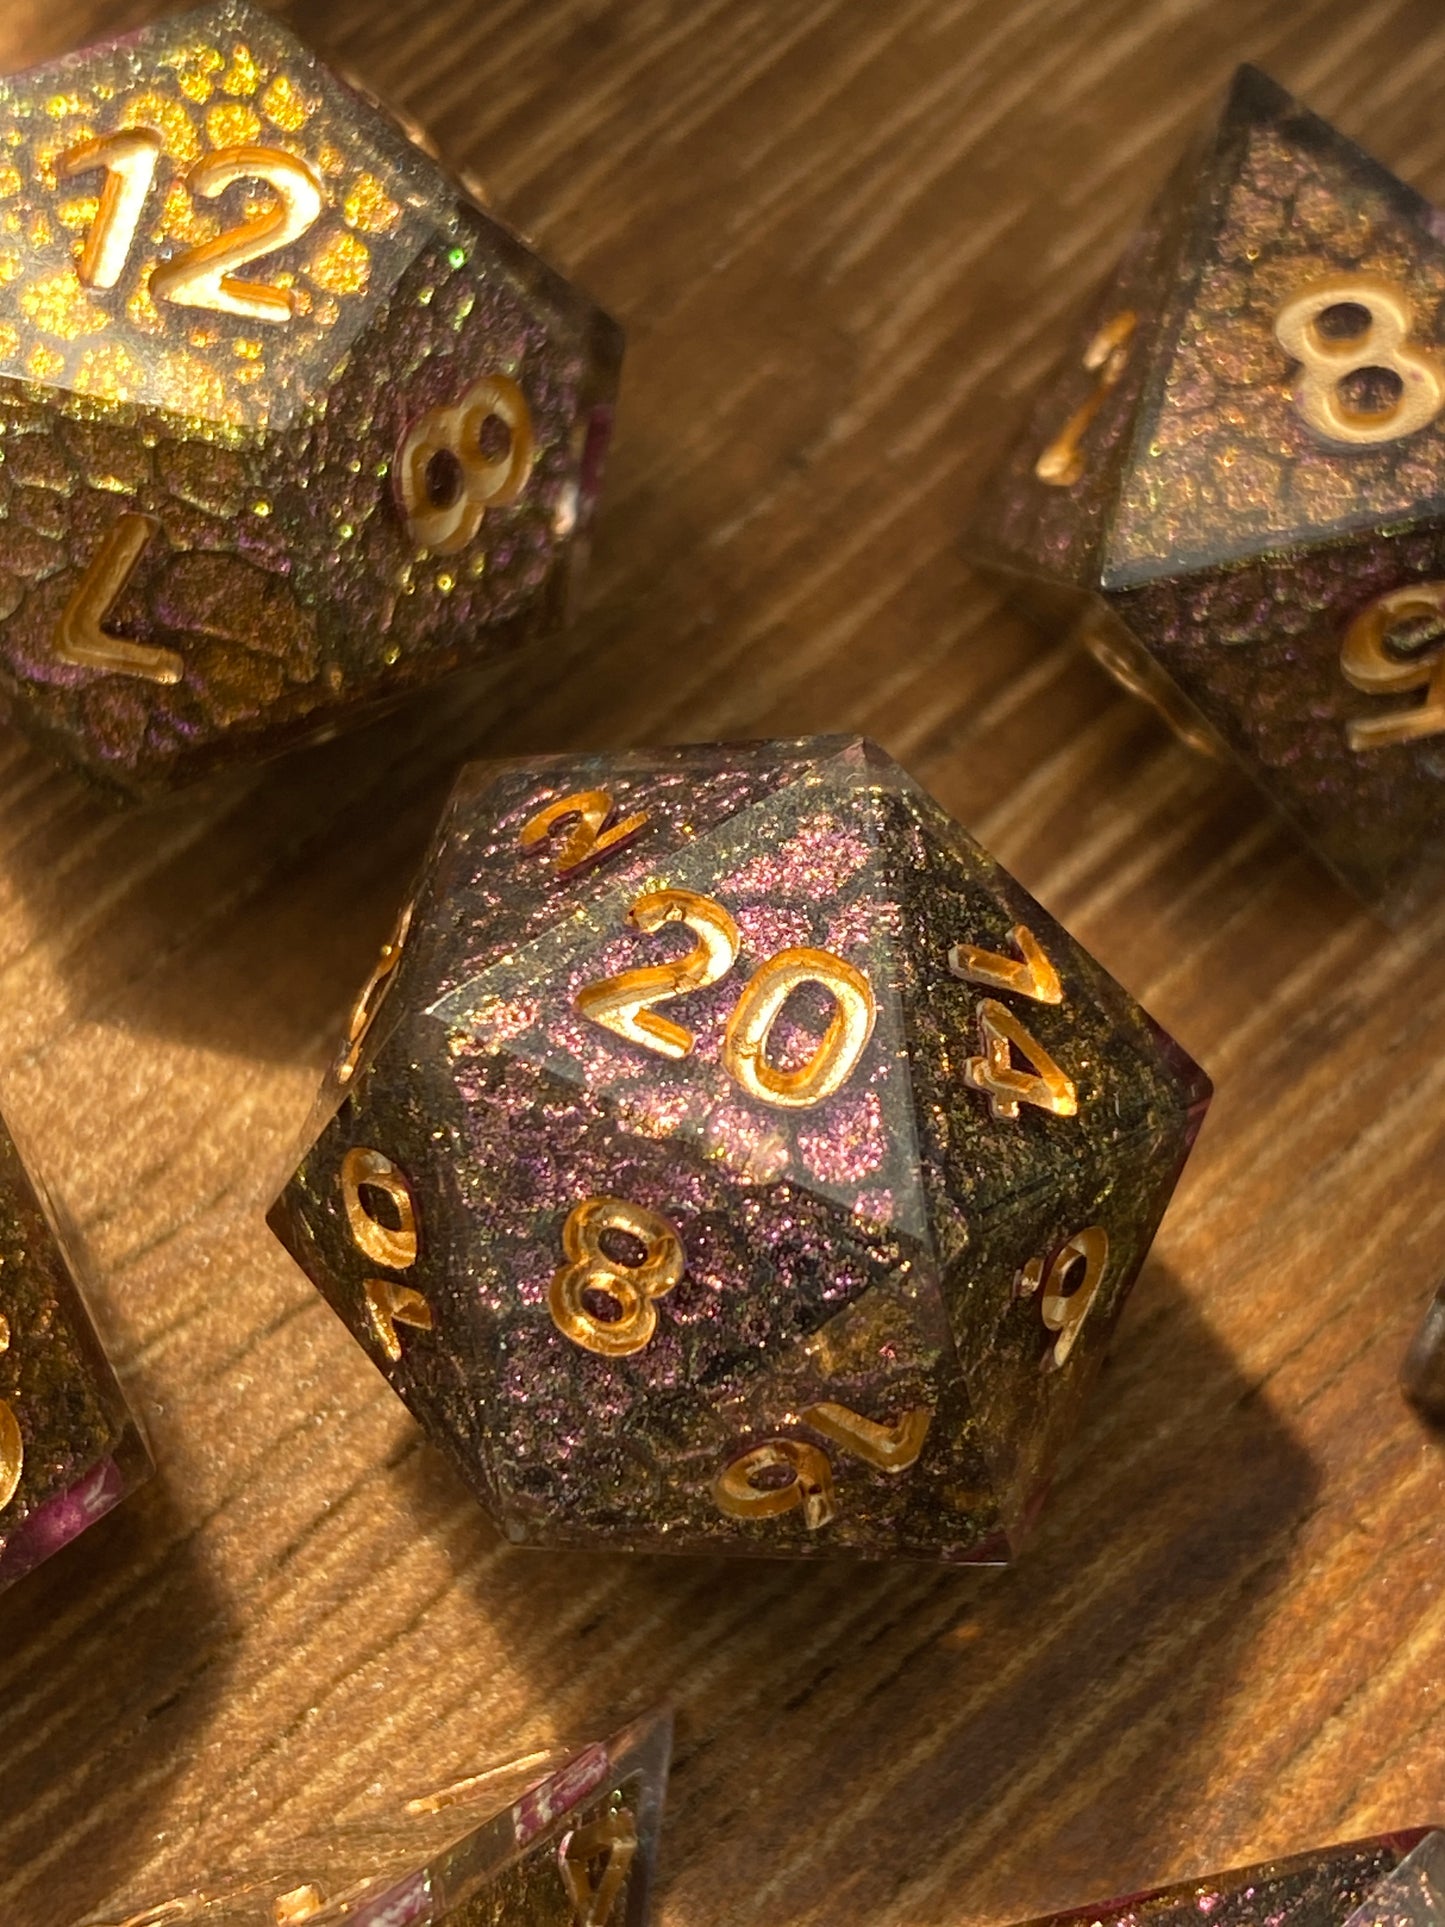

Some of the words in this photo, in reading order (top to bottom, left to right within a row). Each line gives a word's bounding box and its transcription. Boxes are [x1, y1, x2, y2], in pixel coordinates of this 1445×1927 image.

[56, 126, 322, 322] 12
[1275, 274, 1445, 446] 8
[392, 372, 535, 556] 8
[519, 790, 650, 877] 2
[573, 888, 877, 1109] 20
[948, 924, 1078, 1119] 14
[550, 1198, 685, 1357] 8
[711, 1401, 937, 1530] 16
